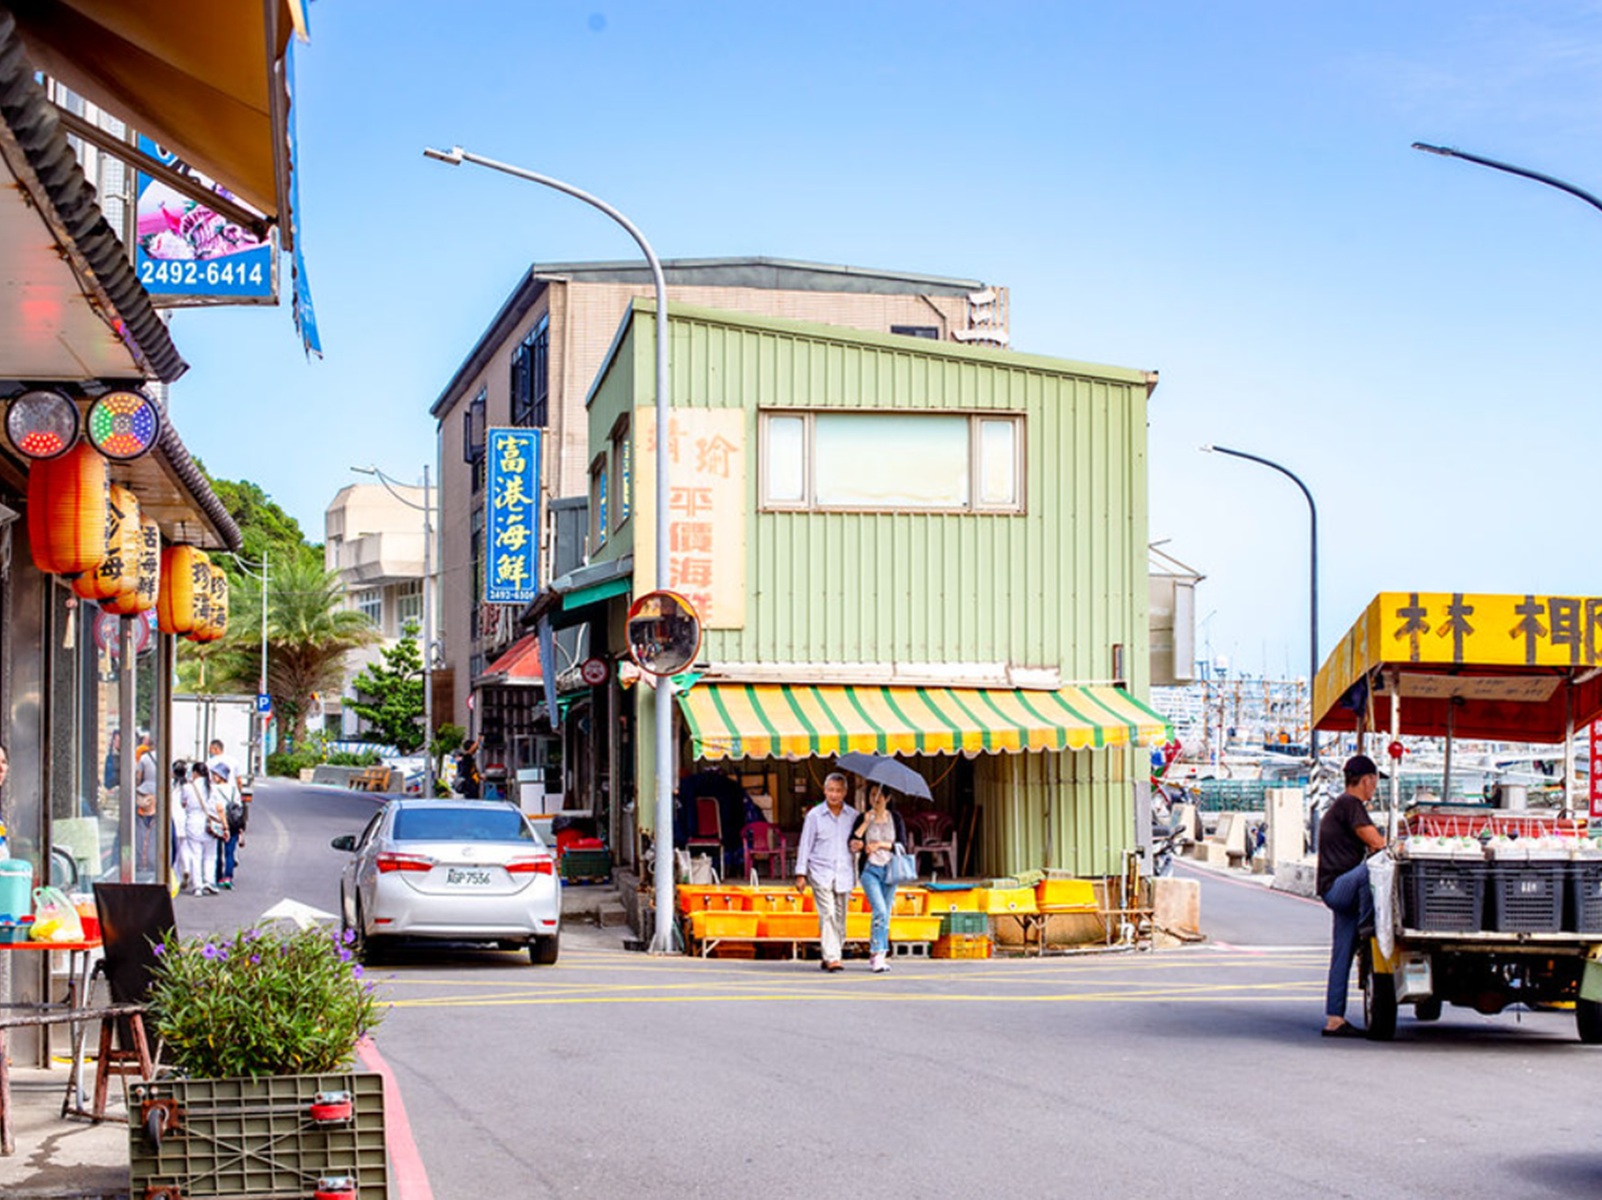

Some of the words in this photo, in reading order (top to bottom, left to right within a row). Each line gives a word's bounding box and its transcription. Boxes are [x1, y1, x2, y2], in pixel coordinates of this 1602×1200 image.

[142, 261, 263, 285] 2492-6414
[494, 434, 534, 592] 富港海鮮
[260, 697, 269, 708] P
